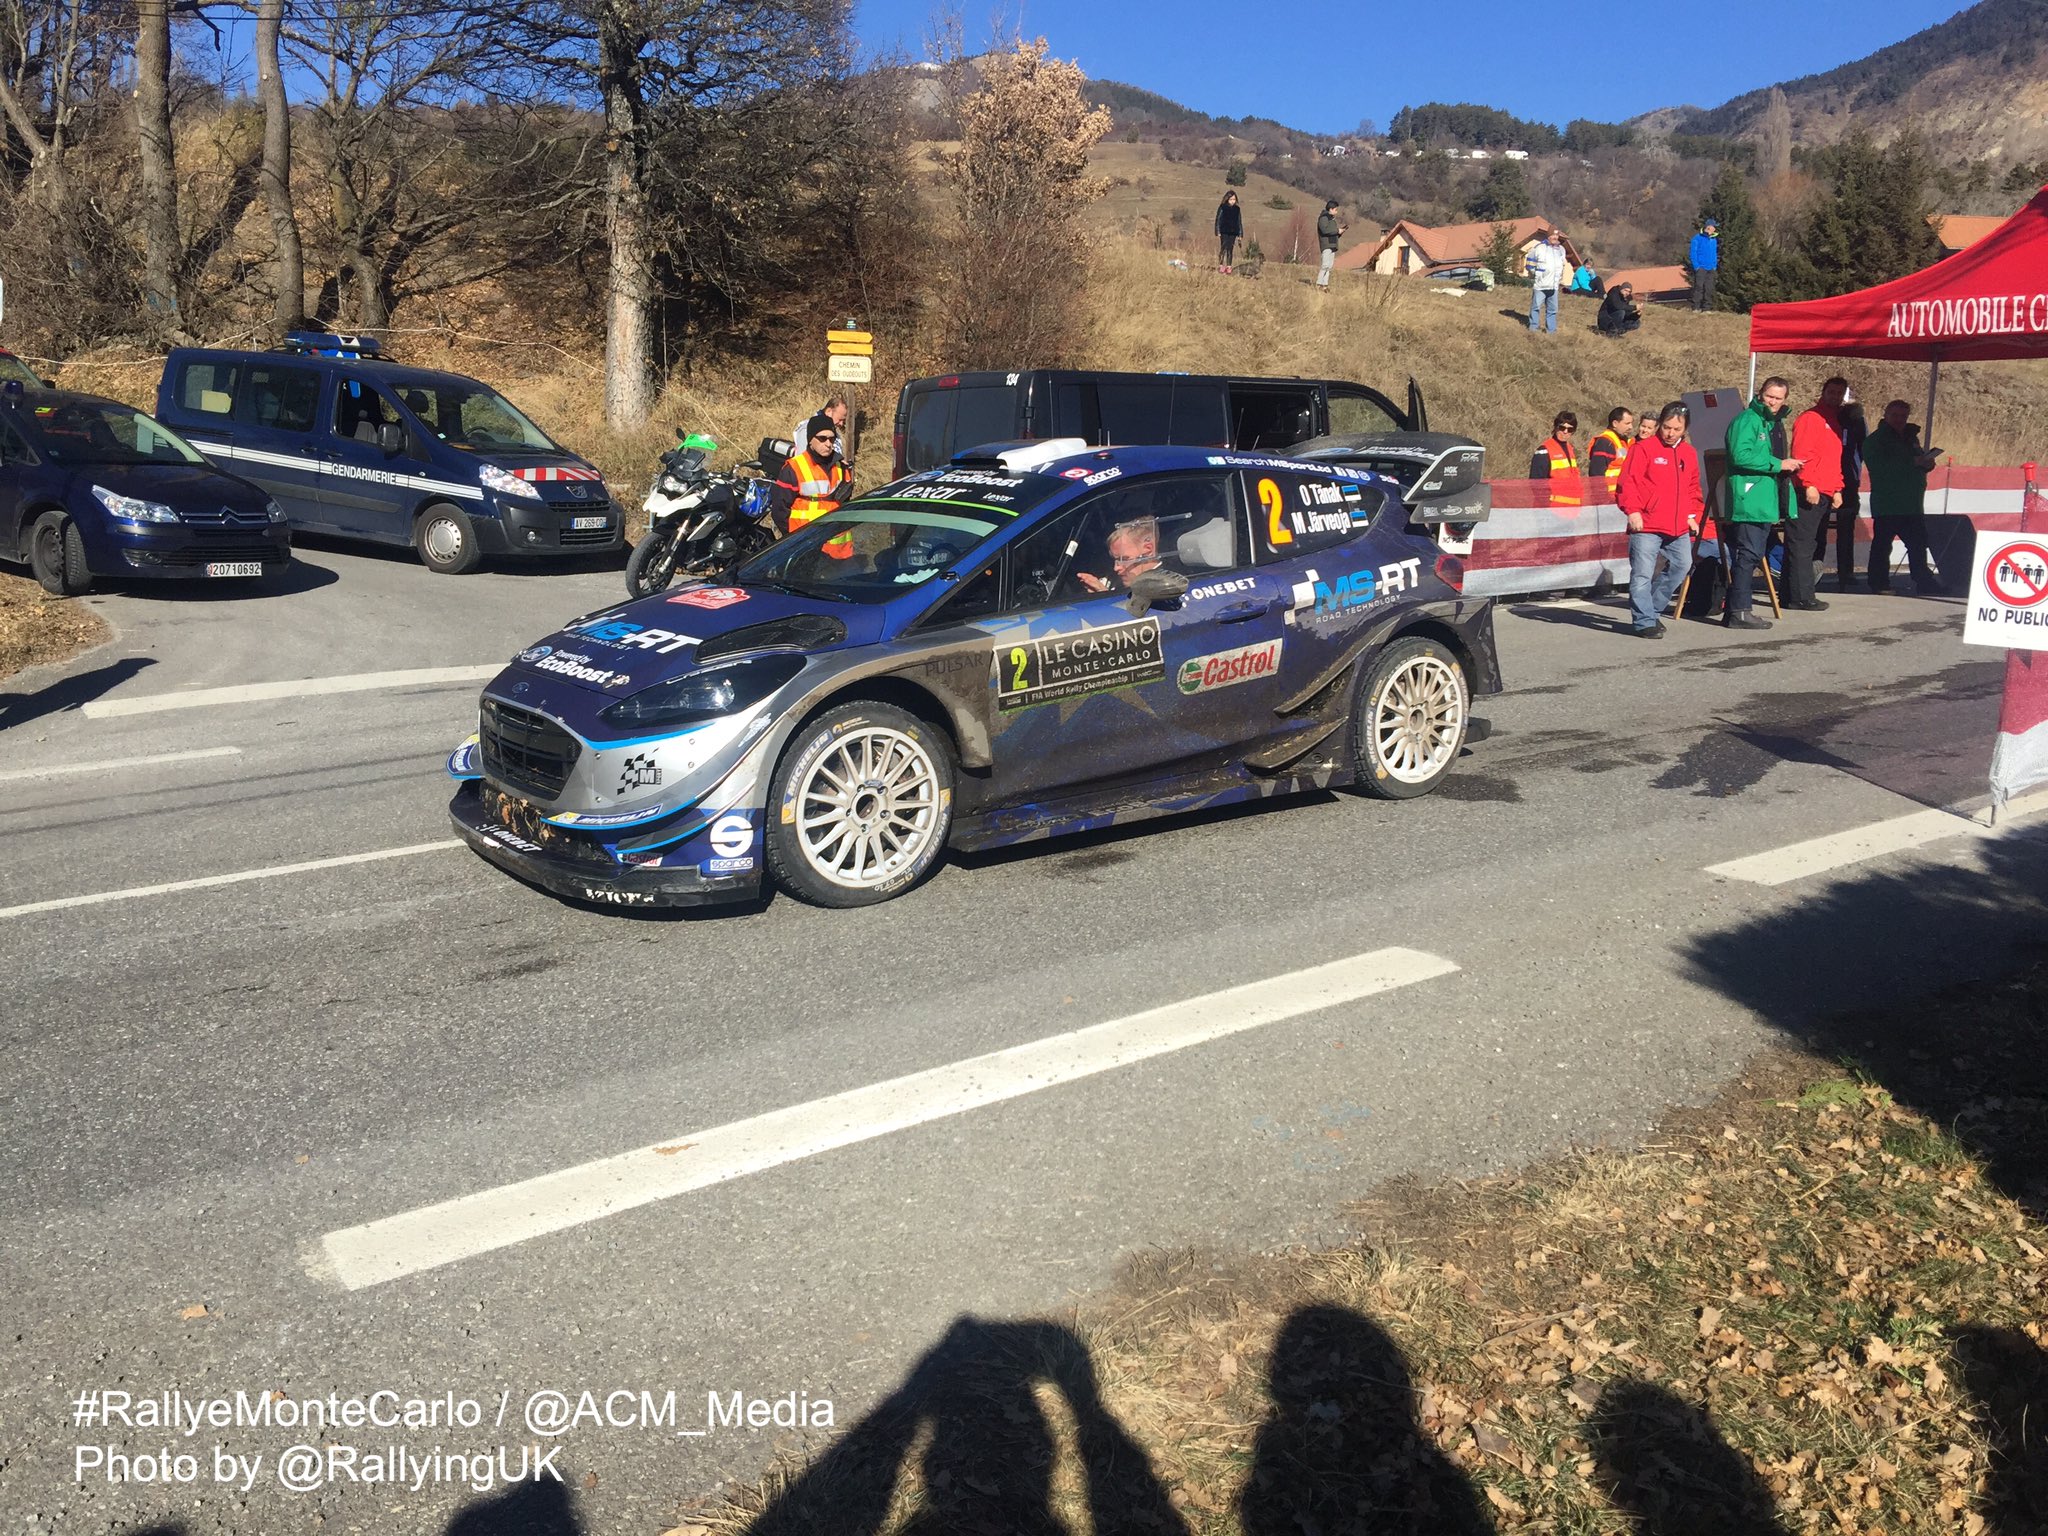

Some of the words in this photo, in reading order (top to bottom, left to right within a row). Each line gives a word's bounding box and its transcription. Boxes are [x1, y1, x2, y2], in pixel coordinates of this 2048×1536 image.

[1888, 295, 2026, 338] AUTOMOBILE
[2029, 294, 2048, 332] C
[838, 361, 861, 369] CHEMIN
[332, 463, 396, 486] GENDARMERIE
[935, 474, 1024, 487] EcoBoost
[891, 484, 967, 499] Lexar
[1299, 485, 1310, 506] O
[1309, 481, 1343, 504] Tänak
[1257, 478, 1293, 545] 2
[1291, 512, 1306, 535] M
[1308, 508, 1352, 535] Järveoja
[1191, 577, 1256, 600] ONEBET
[1313, 557, 1421, 615] MS-RT
[1315, 611, 1342, 624] ROAD
[1345, 594, 1401, 616] TECHNOLOGY
[1977, 607, 1999, 622] NO
[552, 649, 582, 661] Powered
[581, 653, 593, 664] by
[1043, 643, 1067, 665] LE
[1071, 625, 1156, 659] CASINO
[534, 656, 614, 684] EcoBoost
[925, 653, 985, 677] PULSAR
[1010, 647, 1029, 691] 2
[1203, 645, 1275, 687] Castrol
[1045, 687, 1065, 698] World
[788, 732, 829, 796] MICHELIN
[639, 769, 655, 785] M
[712, 858, 753, 869] sparco
